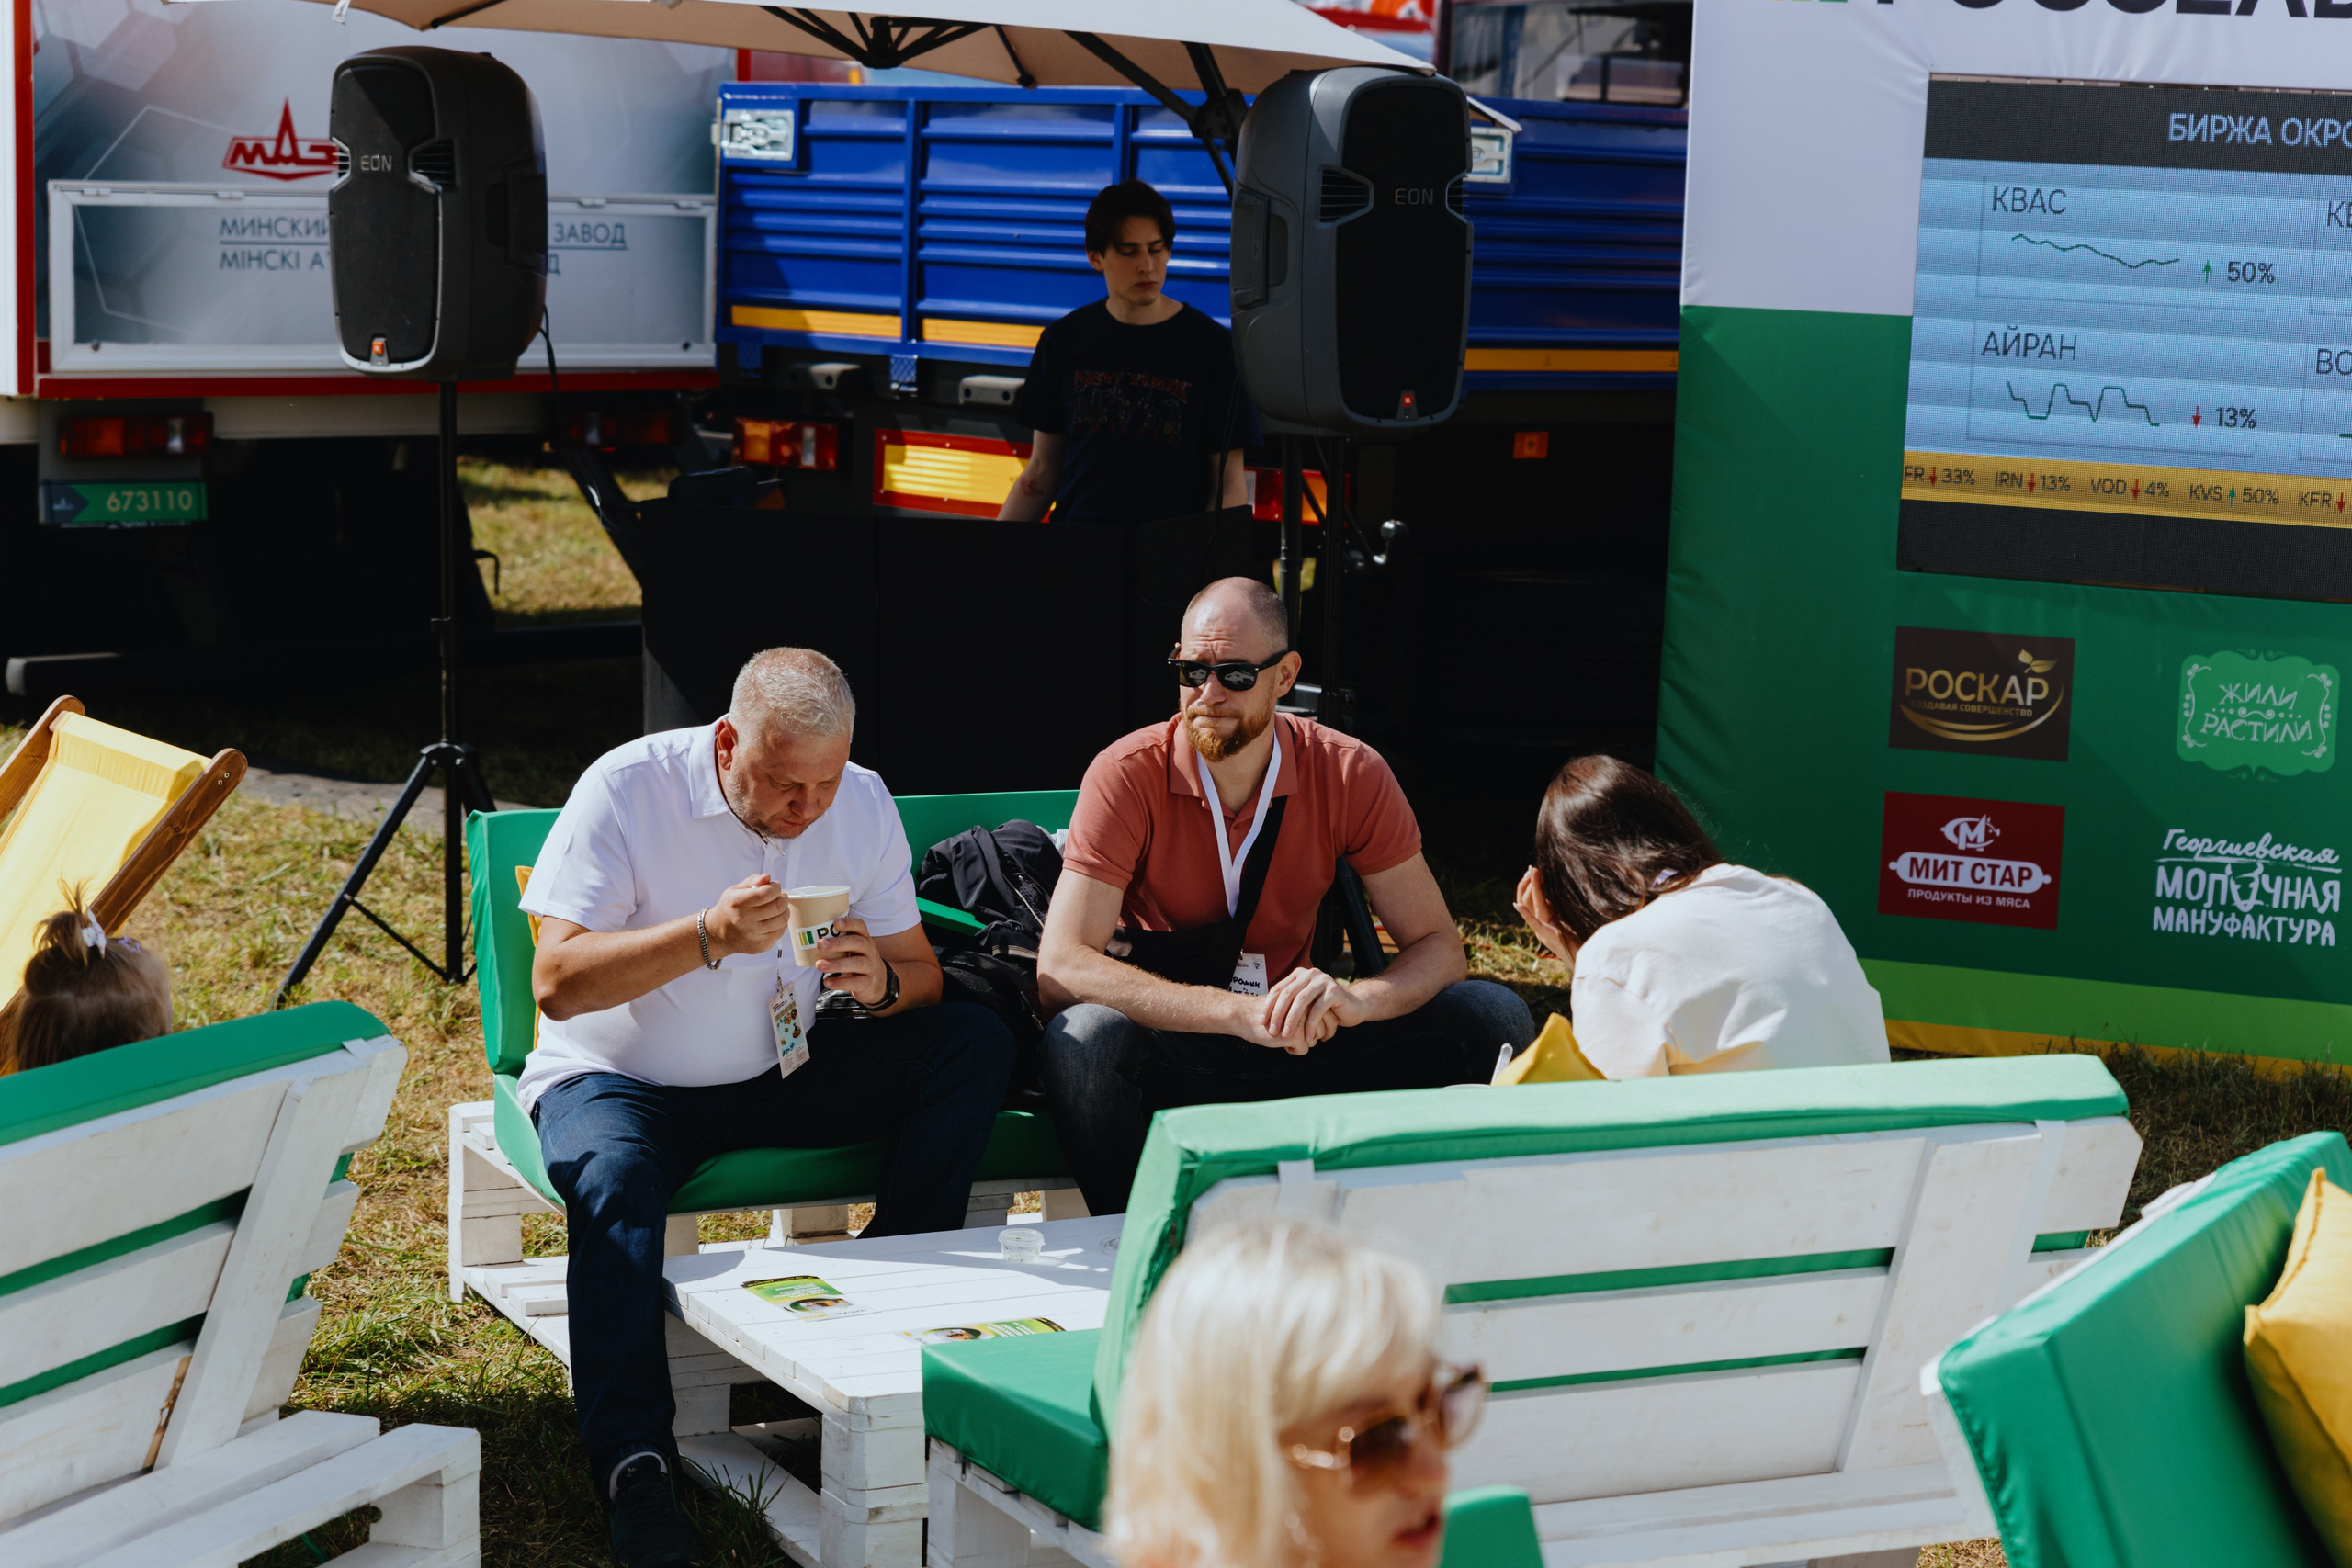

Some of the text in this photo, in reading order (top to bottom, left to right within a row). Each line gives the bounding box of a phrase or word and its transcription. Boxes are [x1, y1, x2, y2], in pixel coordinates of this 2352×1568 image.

[2168, 112, 2273, 145] БИРЖА
[361, 154, 392, 172] EON
[1395, 188, 1433, 205] EON
[1992, 186, 2067, 214] КВАС
[553, 222, 627, 247] ЗАВОД
[220, 249, 300, 270] МІНСКІ
[2227, 261, 2276, 284] 50%
[1981, 324, 2077, 360] АЙРАН
[2215, 407, 2257, 429] 13%
[107, 491, 193, 512] 673110
[1941, 468, 1975, 486] 33%
[1994, 471, 2023, 488] IRN
[2041, 475, 2071, 491] 13%
[2090, 478, 2127, 495] VOD
[2144, 480, 2170, 498] 4%
[2189, 483, 2222, 502] KVS
[2242, 487, 2278, 505] 50%
[2299, 491, 2332, 508] KFR
[1905, 668, 2049, 706] РОСКАР
[2219, 682, 2297, 710] ЖИЛИ
[1910, 700, 2033, 717] СОЗДАВАЯ СОВЕРШЕНСТВО
[2199, 713, 2312, 743] РАСТИЛИ
[2163, 829, 2340, 863] Георгиевская
[1908, 857, 2033, 888] МИТ СТАР
[1908, 888, 2030, 909] ПРОДУКТЫ ИЗ МЯСА
[2153, 906, 2335, 946] МАНУФАКТУРА
